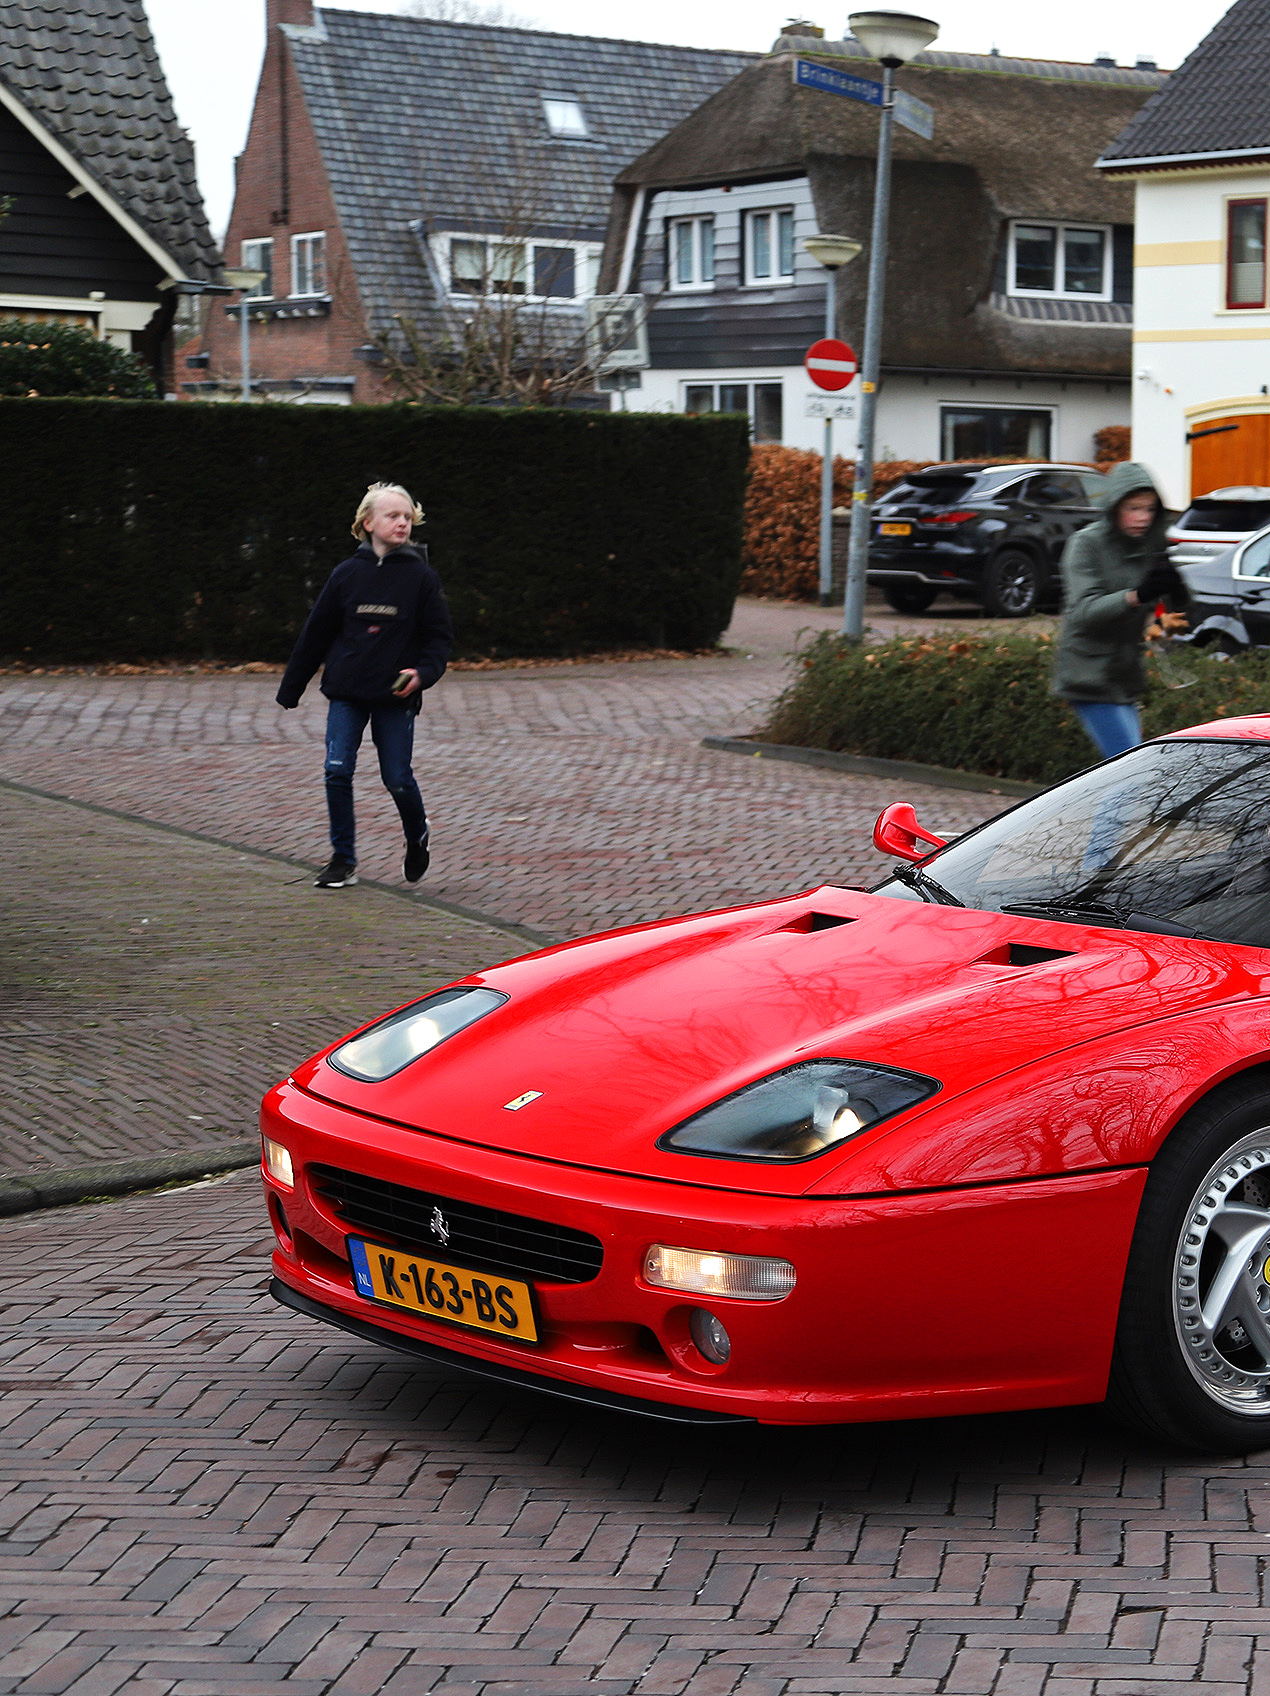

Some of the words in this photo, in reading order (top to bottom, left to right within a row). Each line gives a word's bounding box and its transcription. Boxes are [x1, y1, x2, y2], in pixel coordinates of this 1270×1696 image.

[800, 64, 880, 101] Brinklaantje
[358, 1272, 372, 1287] NL
[378, 1253, 519, 1329] K-163-BS
